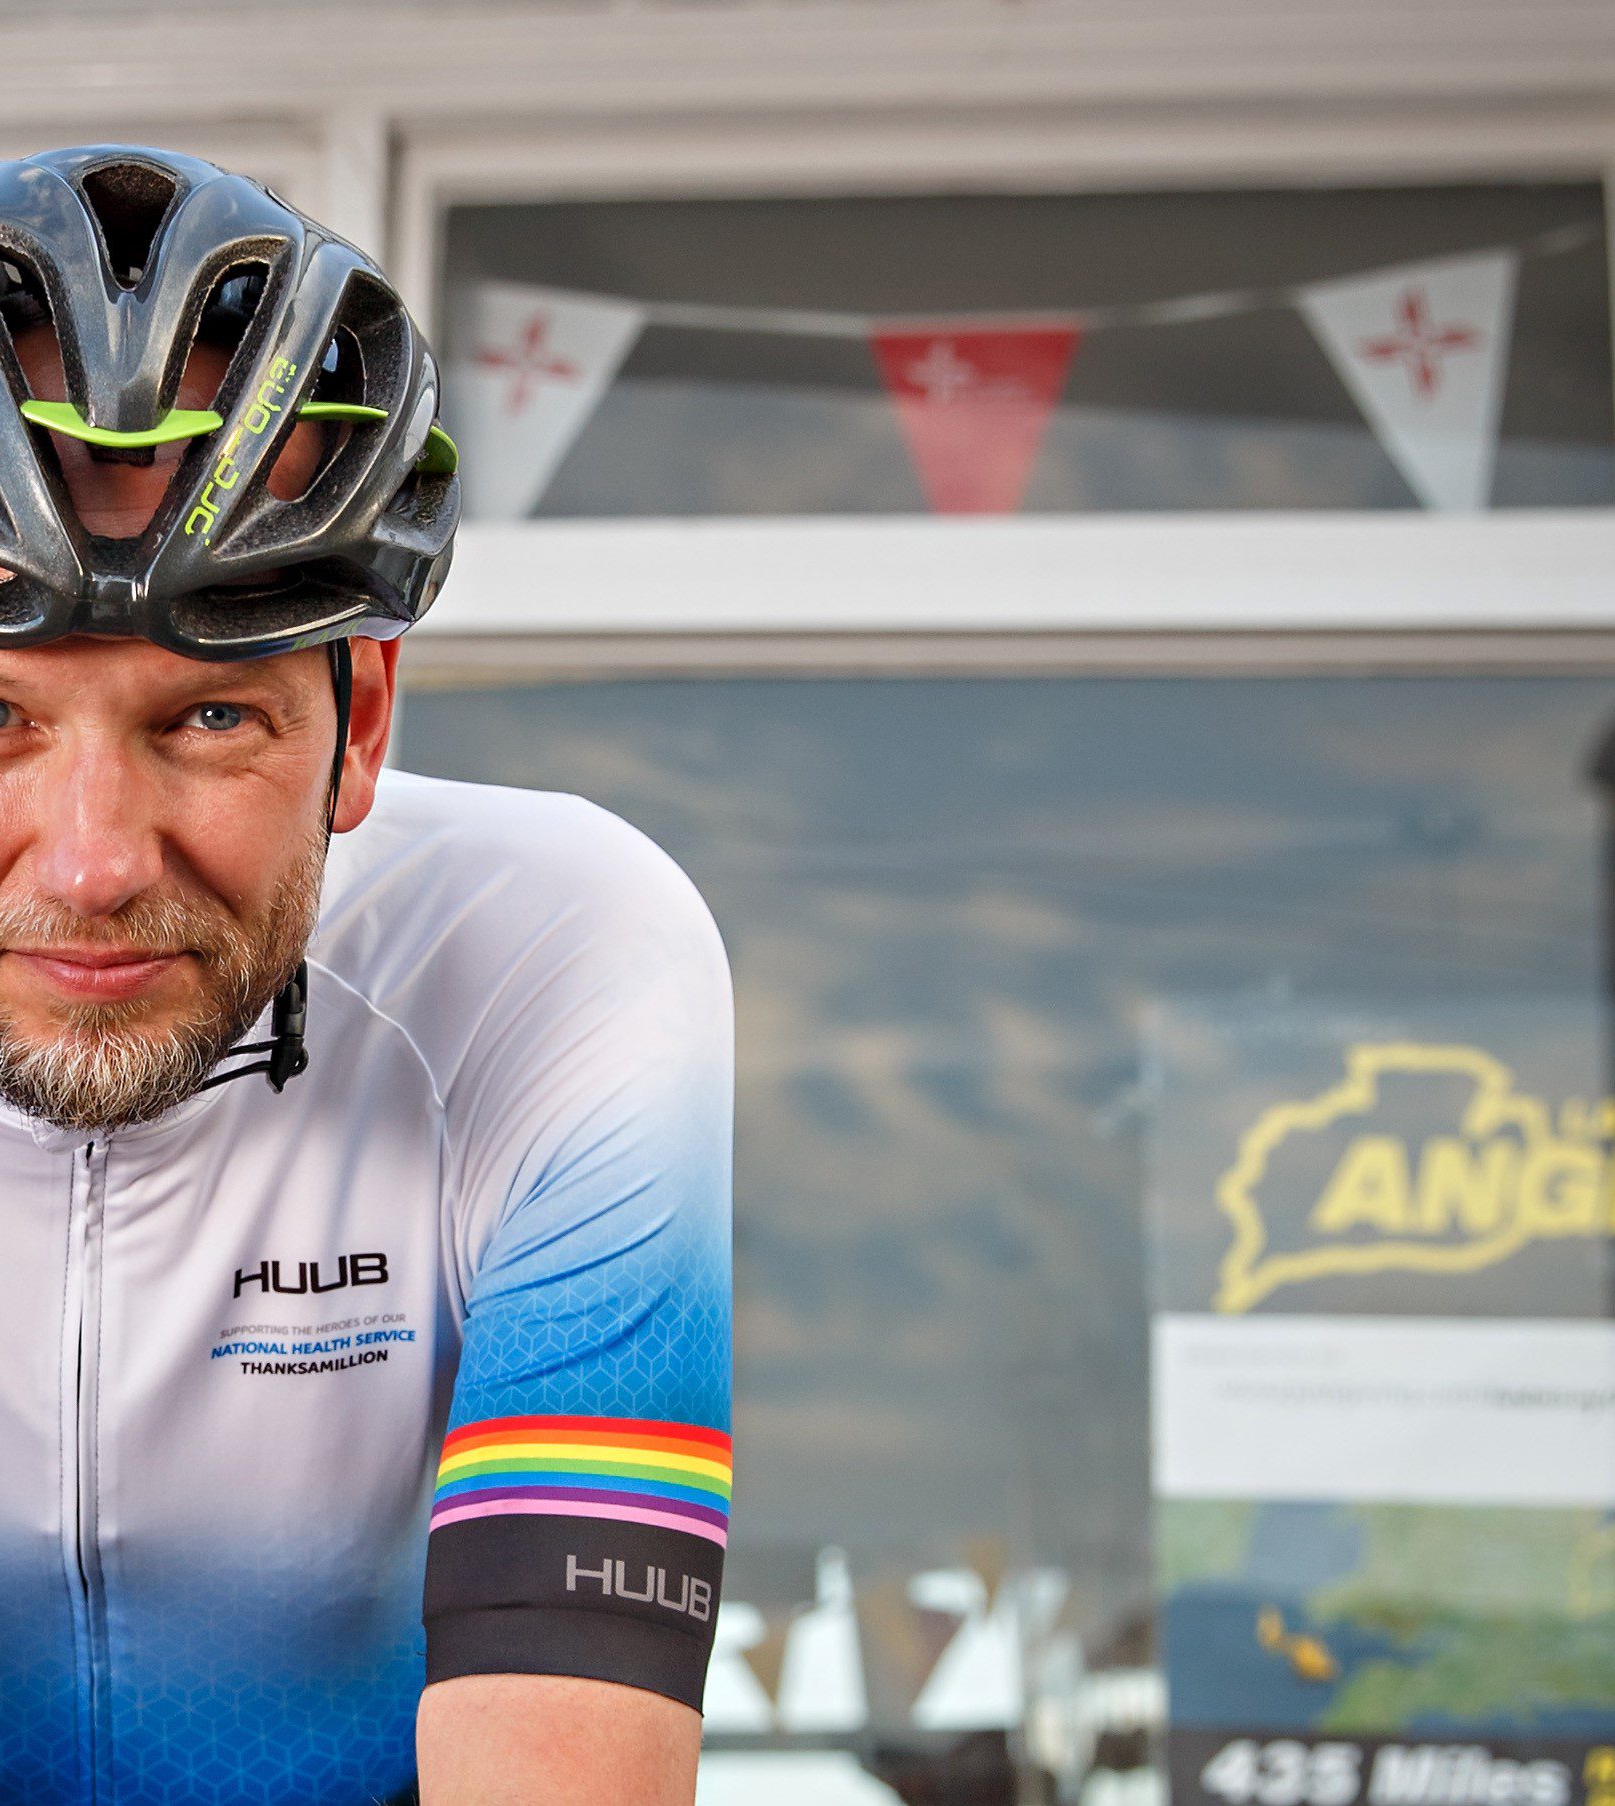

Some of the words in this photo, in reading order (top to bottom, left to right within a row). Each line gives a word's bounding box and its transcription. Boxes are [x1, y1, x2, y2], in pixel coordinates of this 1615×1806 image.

[233, 1252, 389, 1299] HUUB
[219, 1325, 289, 1340] SUPPORTING
[291, 1325, 312, 1336] THE
[316, 1318, 361, 1335] HEROES
[363, 1315, 379, 1326] OF
[381, 1313, 407, 1324] OUR
[210, 1341, 288, 1360] NATIONAL
[291, 1336, 352, 1355] HEALTH
[355, 1329, 416, 1347] SERVICE
[240, 1349, 390, 1376] THANKSAMILLION
[565, 1553, 713, 1623] HUUB
